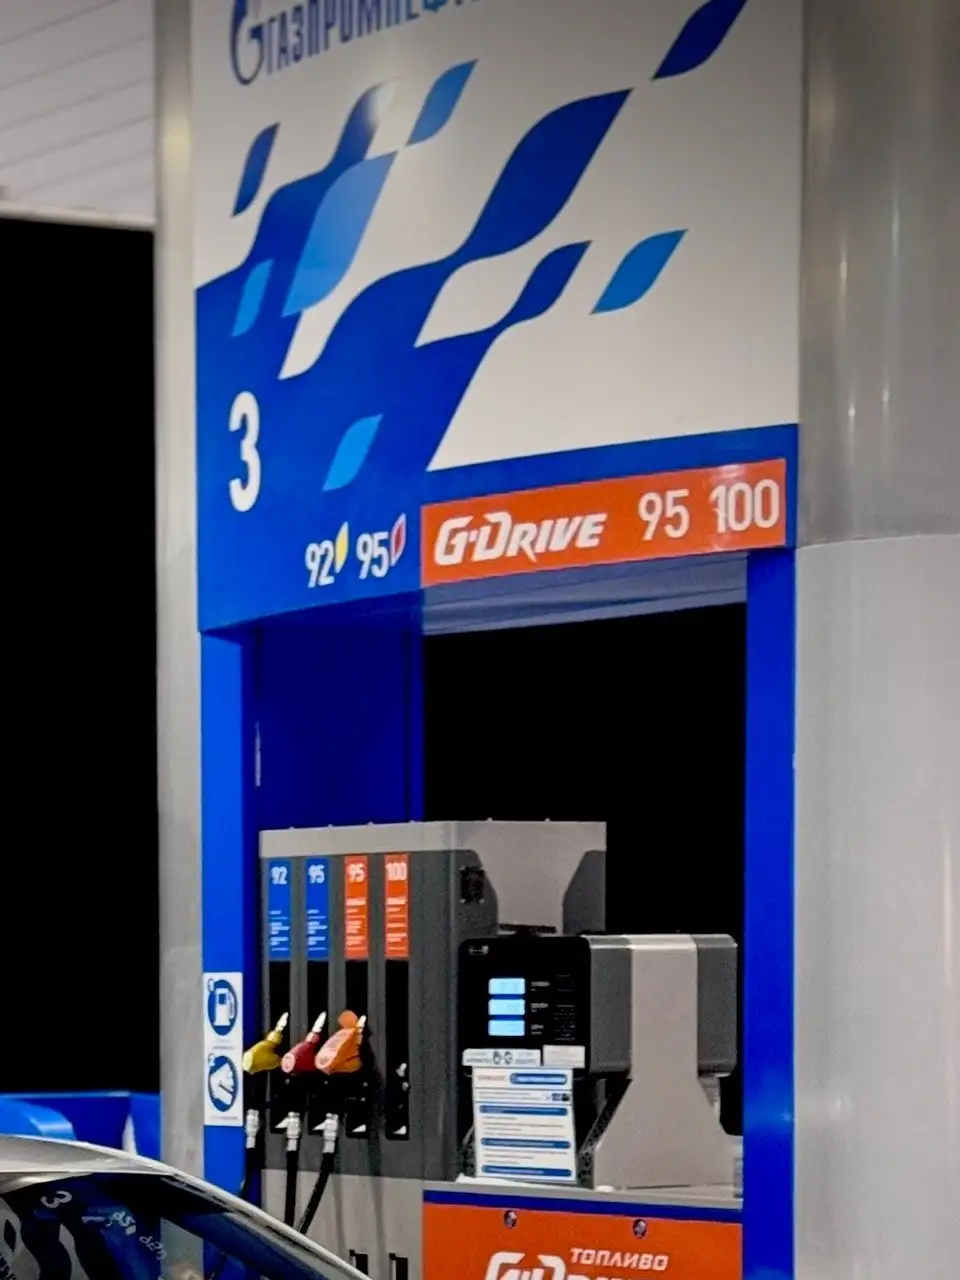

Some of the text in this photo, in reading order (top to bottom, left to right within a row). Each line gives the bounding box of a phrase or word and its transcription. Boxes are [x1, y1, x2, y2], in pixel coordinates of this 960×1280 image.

[229, 390, 262, 512] 3
[637, 488, 690, 541] 95
[709, 478, 781, 534] 100
[305, 530, 390, 589] 92 95
[270, 866, 288, 885] 92
[308, 864, 326, 883] 95
[385, 861, 408, 881] 100
[570, 1247, 669, 1272] ТОПЛИВО
